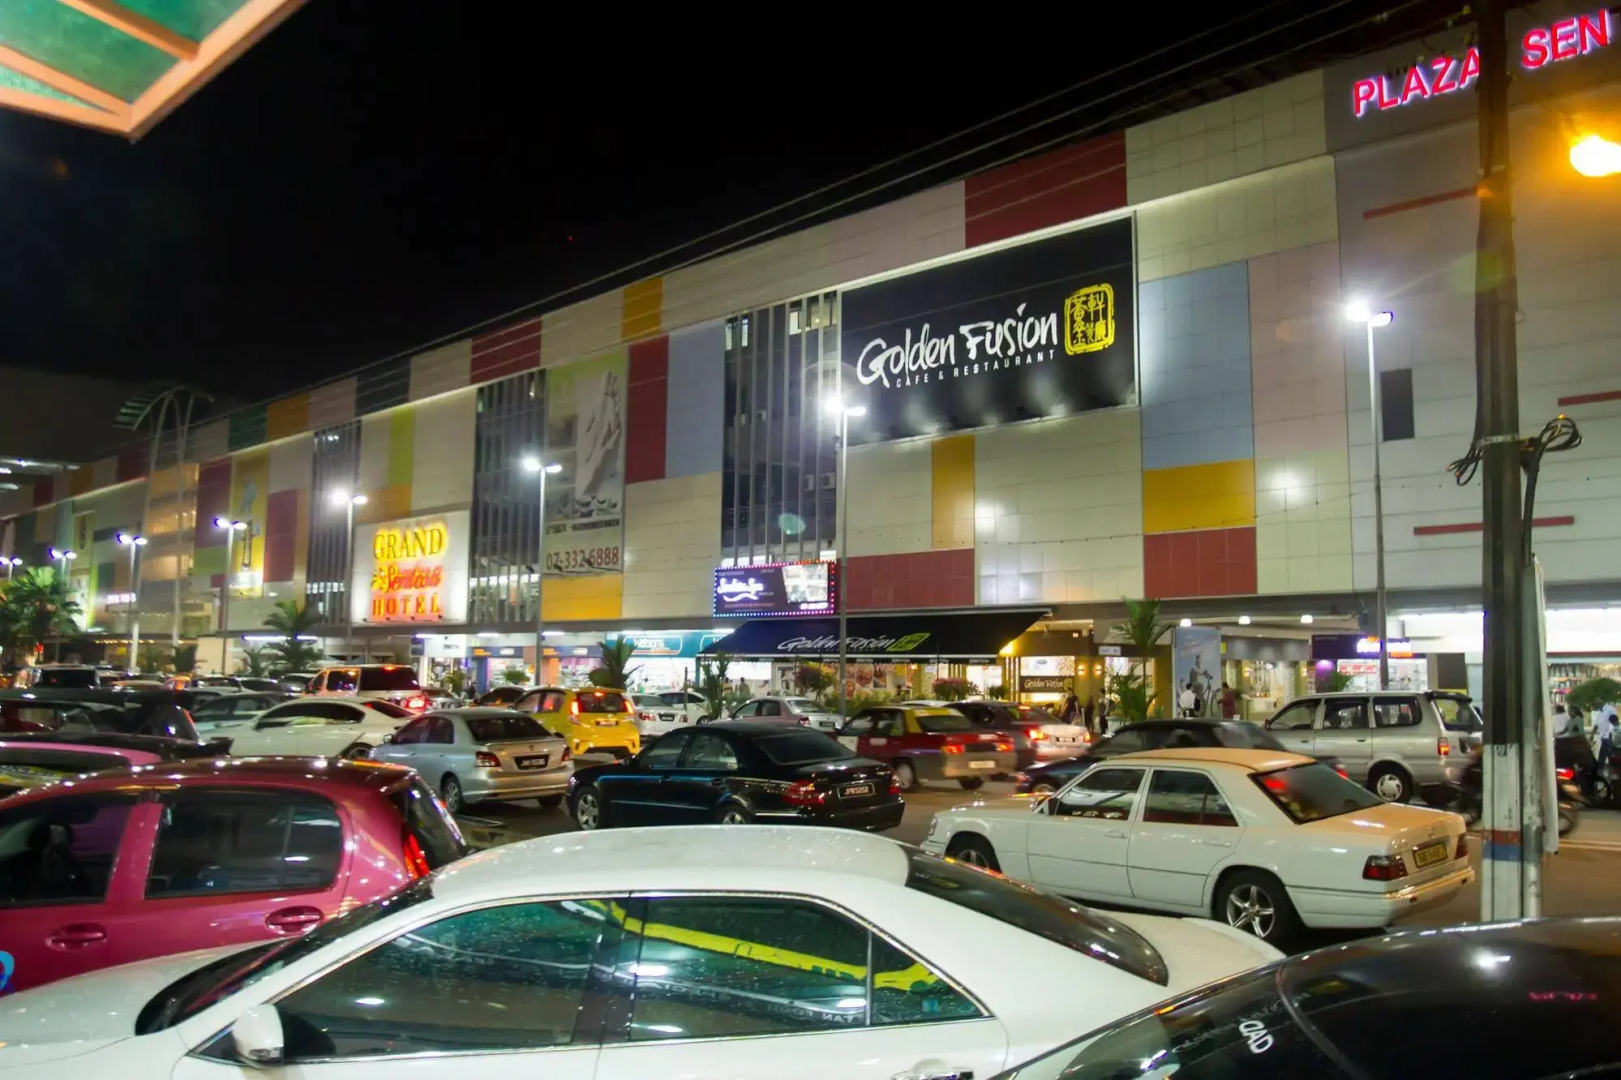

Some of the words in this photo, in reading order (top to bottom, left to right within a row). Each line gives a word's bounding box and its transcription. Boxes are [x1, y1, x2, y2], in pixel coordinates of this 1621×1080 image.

[1353, 47, 1480, 117] PLAZA
[1521, 9, 1611, 69] SEN
[856, 323, 955, 388] Golden
[959, 302, 1058, 360] Fusion
[896, 373, 930, 388] CAFE
[953, 349, 1056, 378] RESTAURANT
[373, 527, 443, 560] GRAND
[372, 592, 441, 616] HOTEL
